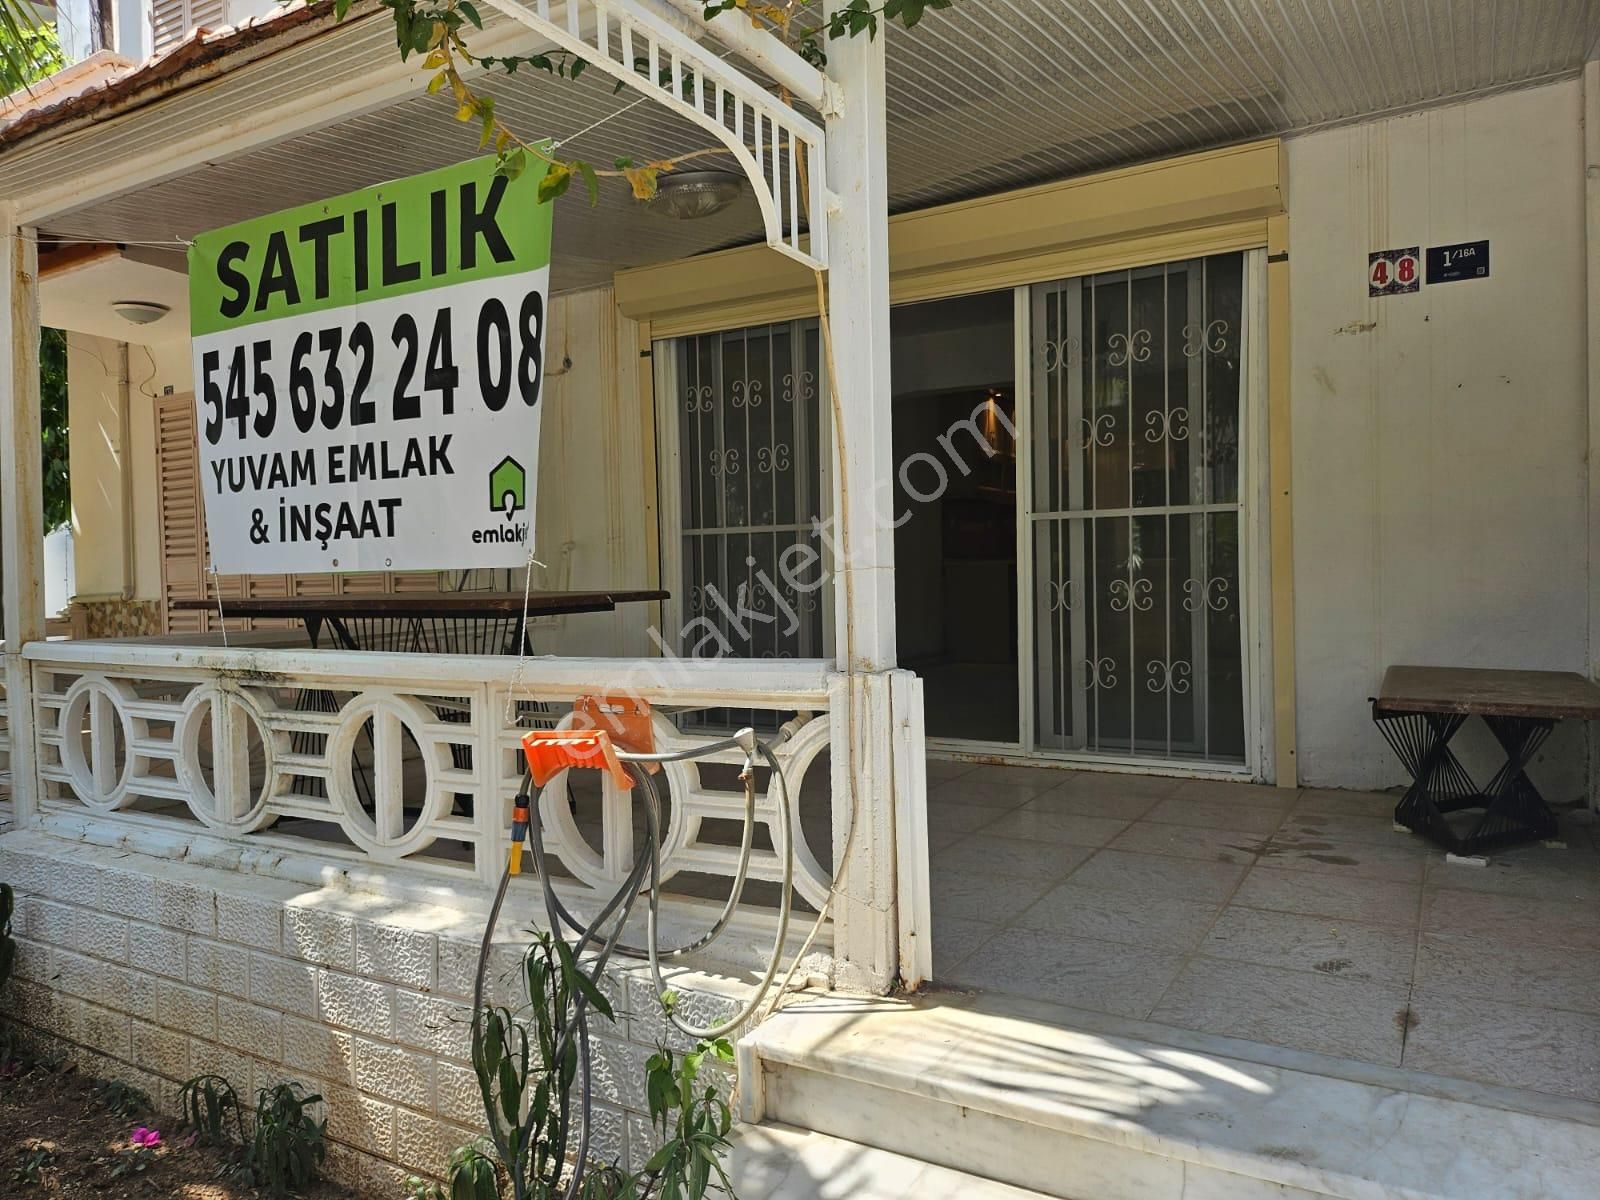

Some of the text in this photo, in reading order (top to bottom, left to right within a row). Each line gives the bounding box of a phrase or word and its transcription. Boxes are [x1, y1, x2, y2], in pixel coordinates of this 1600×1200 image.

[216, 175, 516, 318] SATILIK
[202, 290, 543, 445] 545 632 24 08
[210, 433, 455, 495] YUVAM EMLAK
[249, 496, 402, 551] & İNŞAAT
